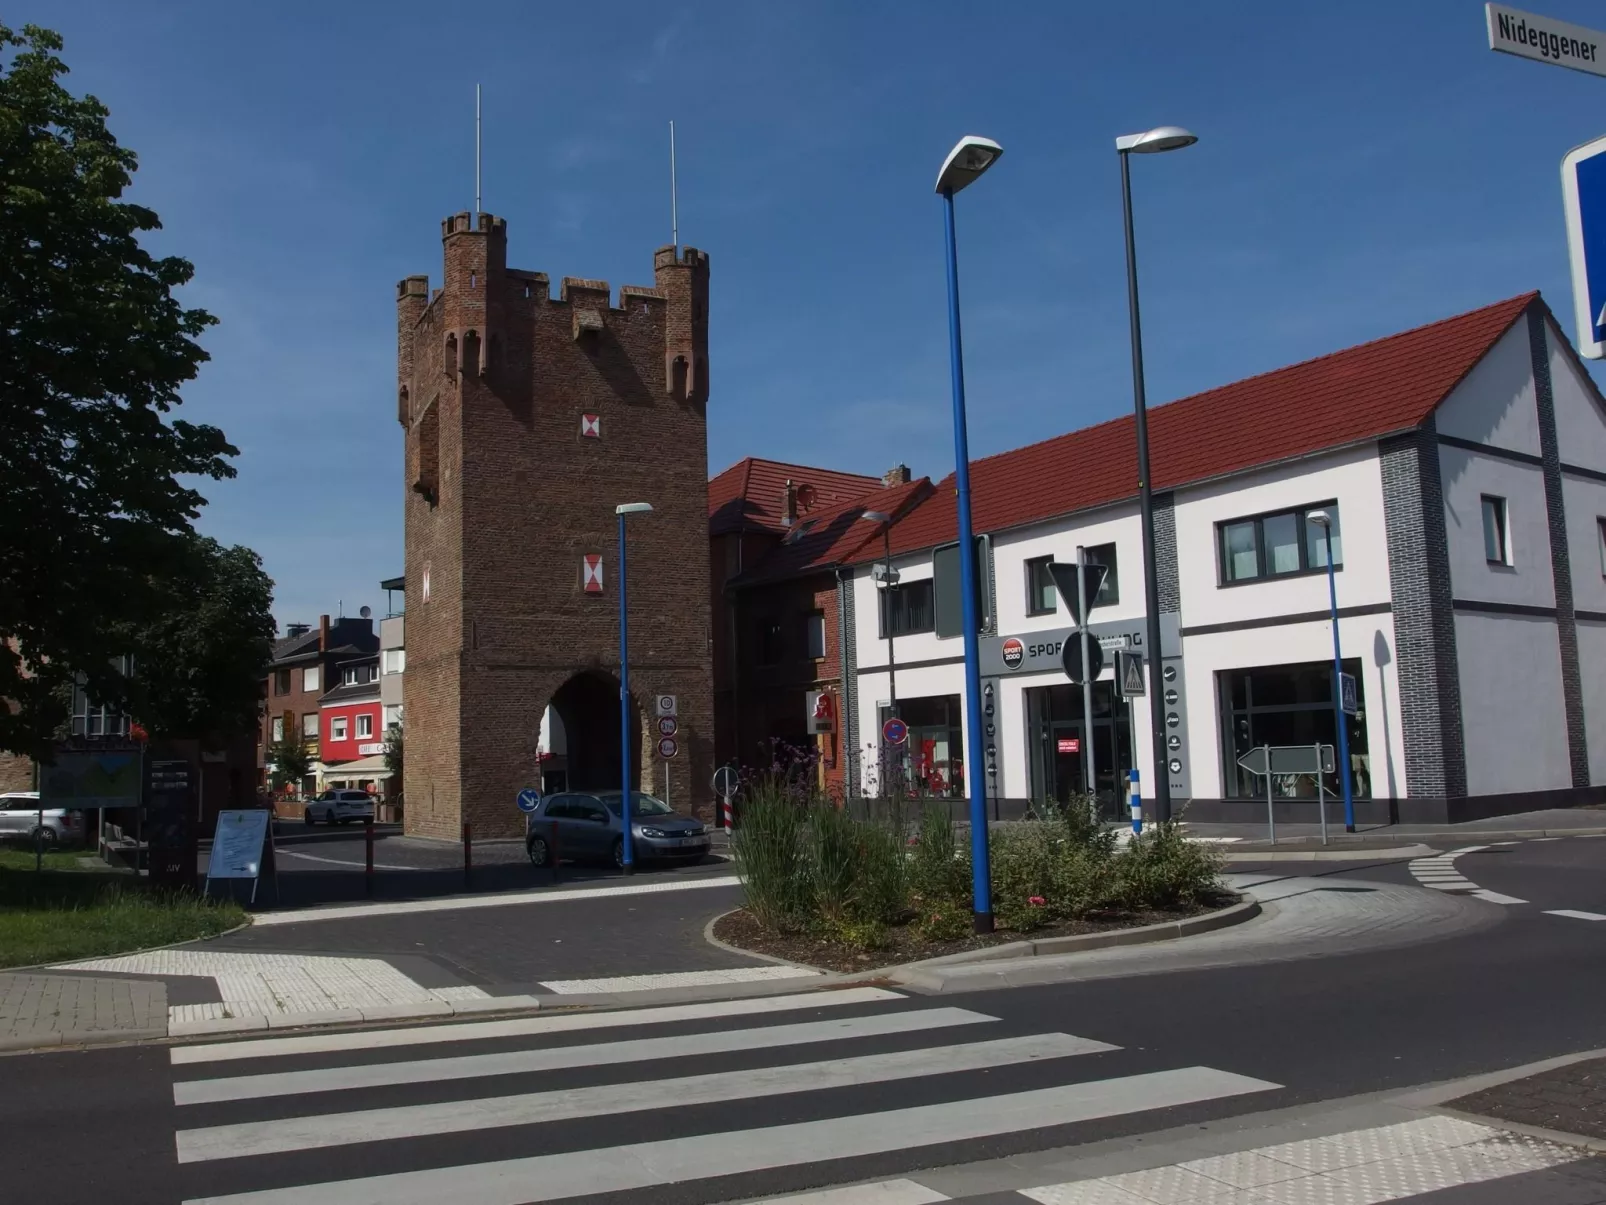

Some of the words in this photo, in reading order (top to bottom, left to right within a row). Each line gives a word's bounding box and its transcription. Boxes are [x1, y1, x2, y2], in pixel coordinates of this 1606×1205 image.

[1497, 12, 1597, 62] Nideggener
[1004, 646, 1022, 655] SPORT
[1005, 653, 1021, 661] 2000
